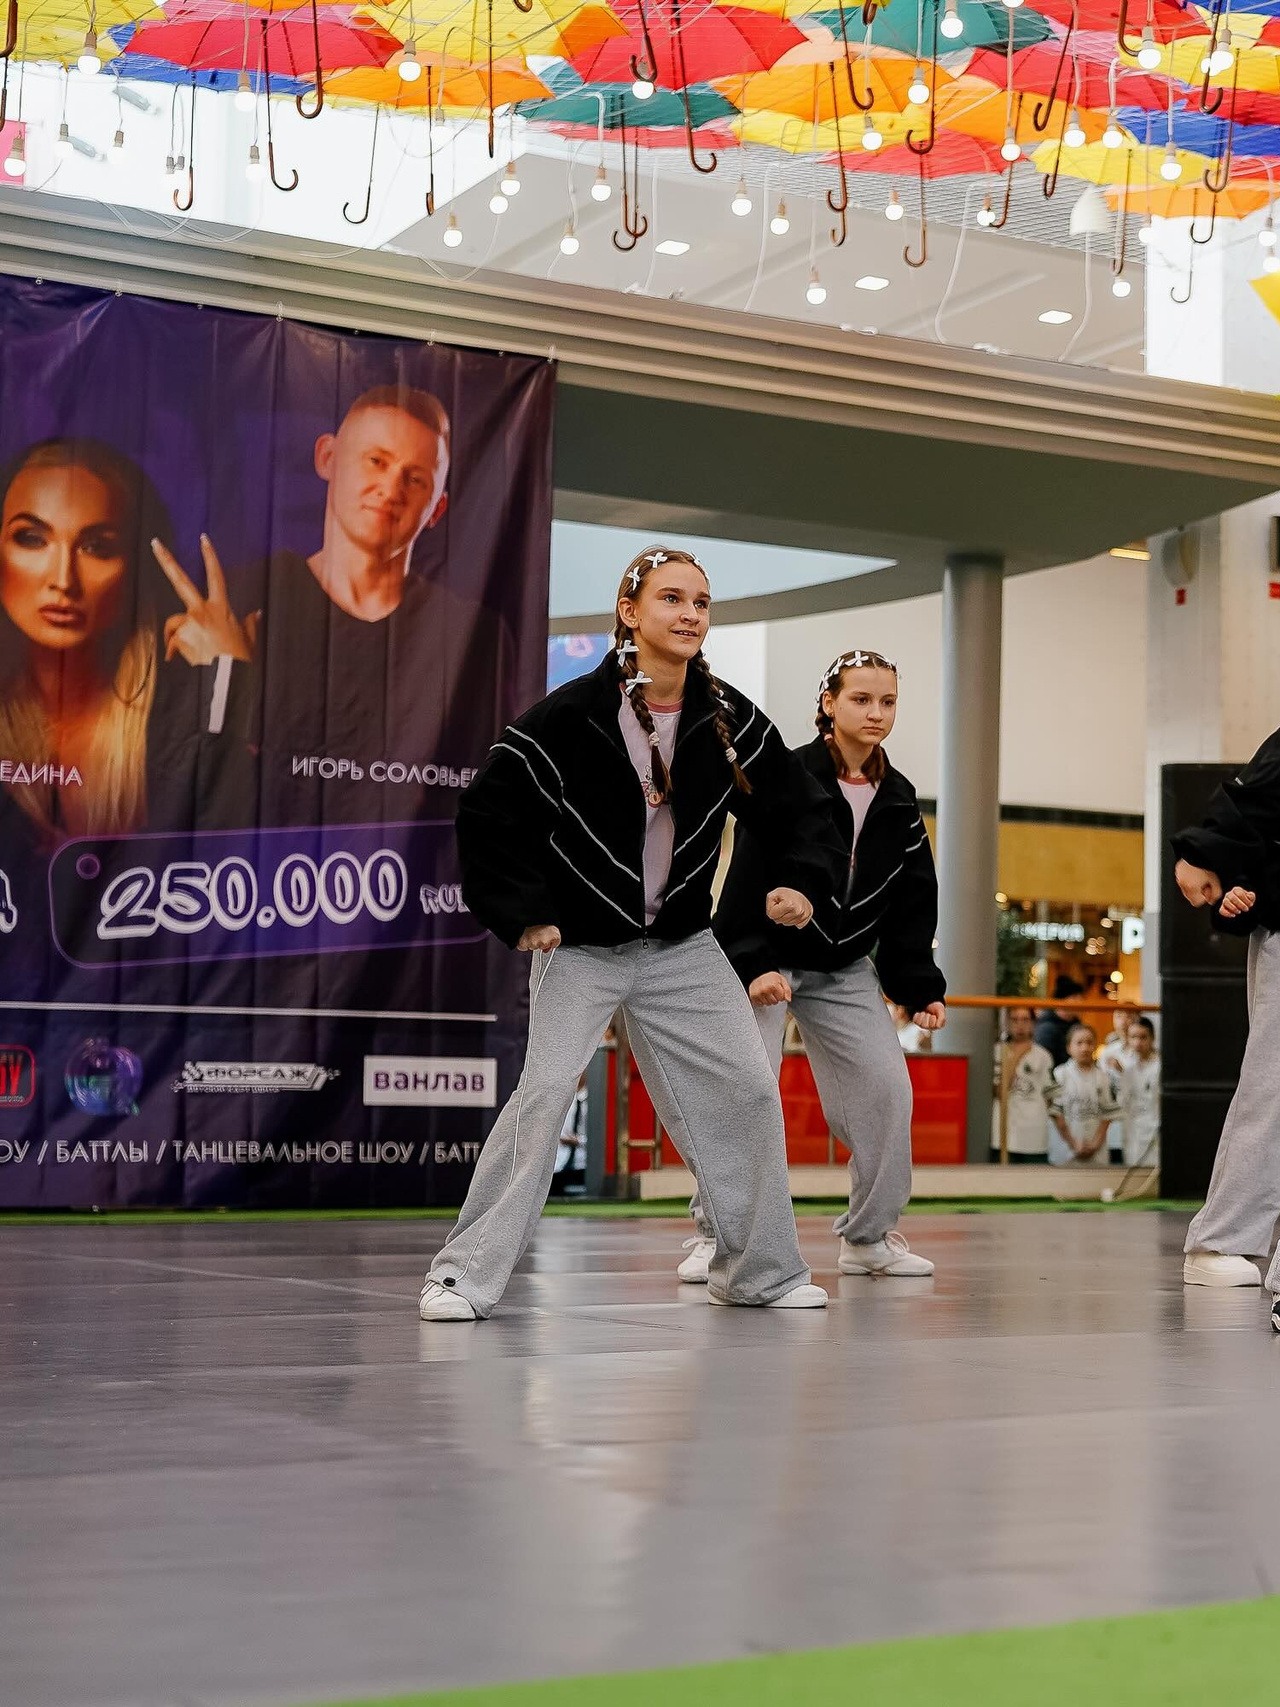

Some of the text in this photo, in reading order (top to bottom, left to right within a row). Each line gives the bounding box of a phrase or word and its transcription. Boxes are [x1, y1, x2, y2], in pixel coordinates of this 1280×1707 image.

[0, 760, 83, 787] ЕДИНА
[292, 755, 364, 781] ИГОРЬ
[96, 848, 408, 940] 250.000
[374, 1070, 486, 1092] ванлав
[56, 1140, 148, 1163] БАТТЛЫ
[172, 1140, 352, 1165] ТАНЦЕВАЛЬНОЕ
[359, 1141, 414, 1164] ШОУ
